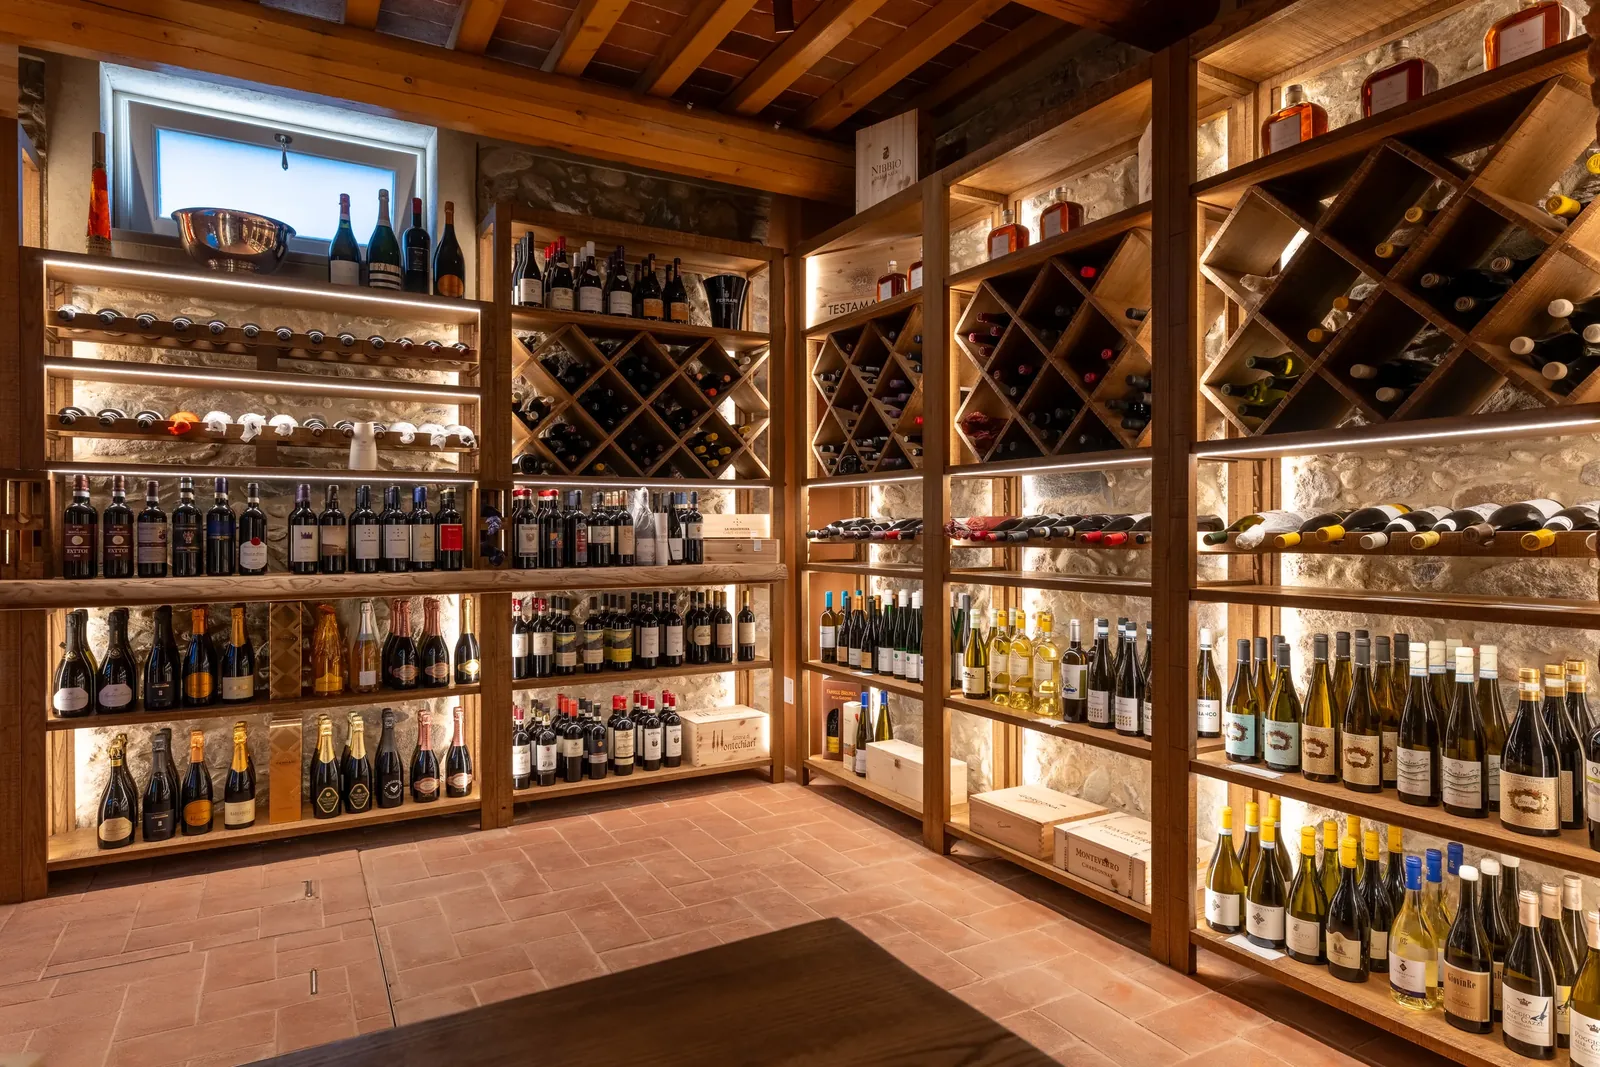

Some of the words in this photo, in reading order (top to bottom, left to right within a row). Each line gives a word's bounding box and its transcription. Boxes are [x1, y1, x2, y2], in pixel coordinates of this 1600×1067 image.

[871, 159, 901, 176] NIBBIO
[1076, 848, 1119, 872] MONTEVERRO
[1082, 862, 1113, 878] CHARDONNAY
[1506, 1004, 1531, 1019] POGGIO
